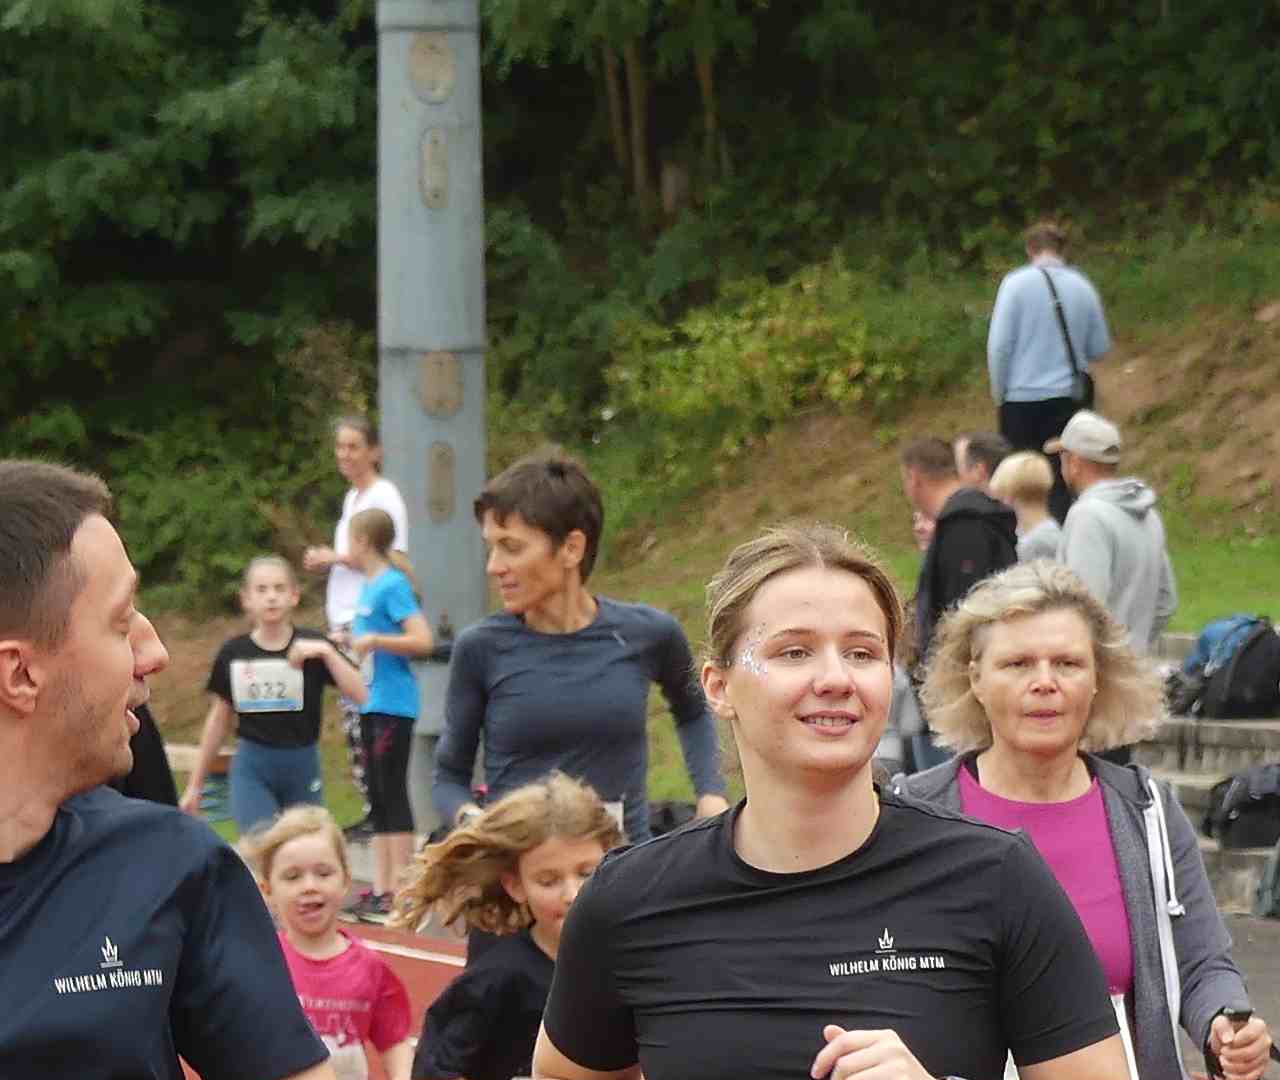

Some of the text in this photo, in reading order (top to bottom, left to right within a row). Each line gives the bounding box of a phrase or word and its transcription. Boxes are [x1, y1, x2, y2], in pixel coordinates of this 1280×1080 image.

[829, 959, 880, 976] WILHELM
[882, 955, 917, 971] KÖNIG
[54, 974, 108, 994] WILHELM
[109, 969, 142, 988] KÖNIG
